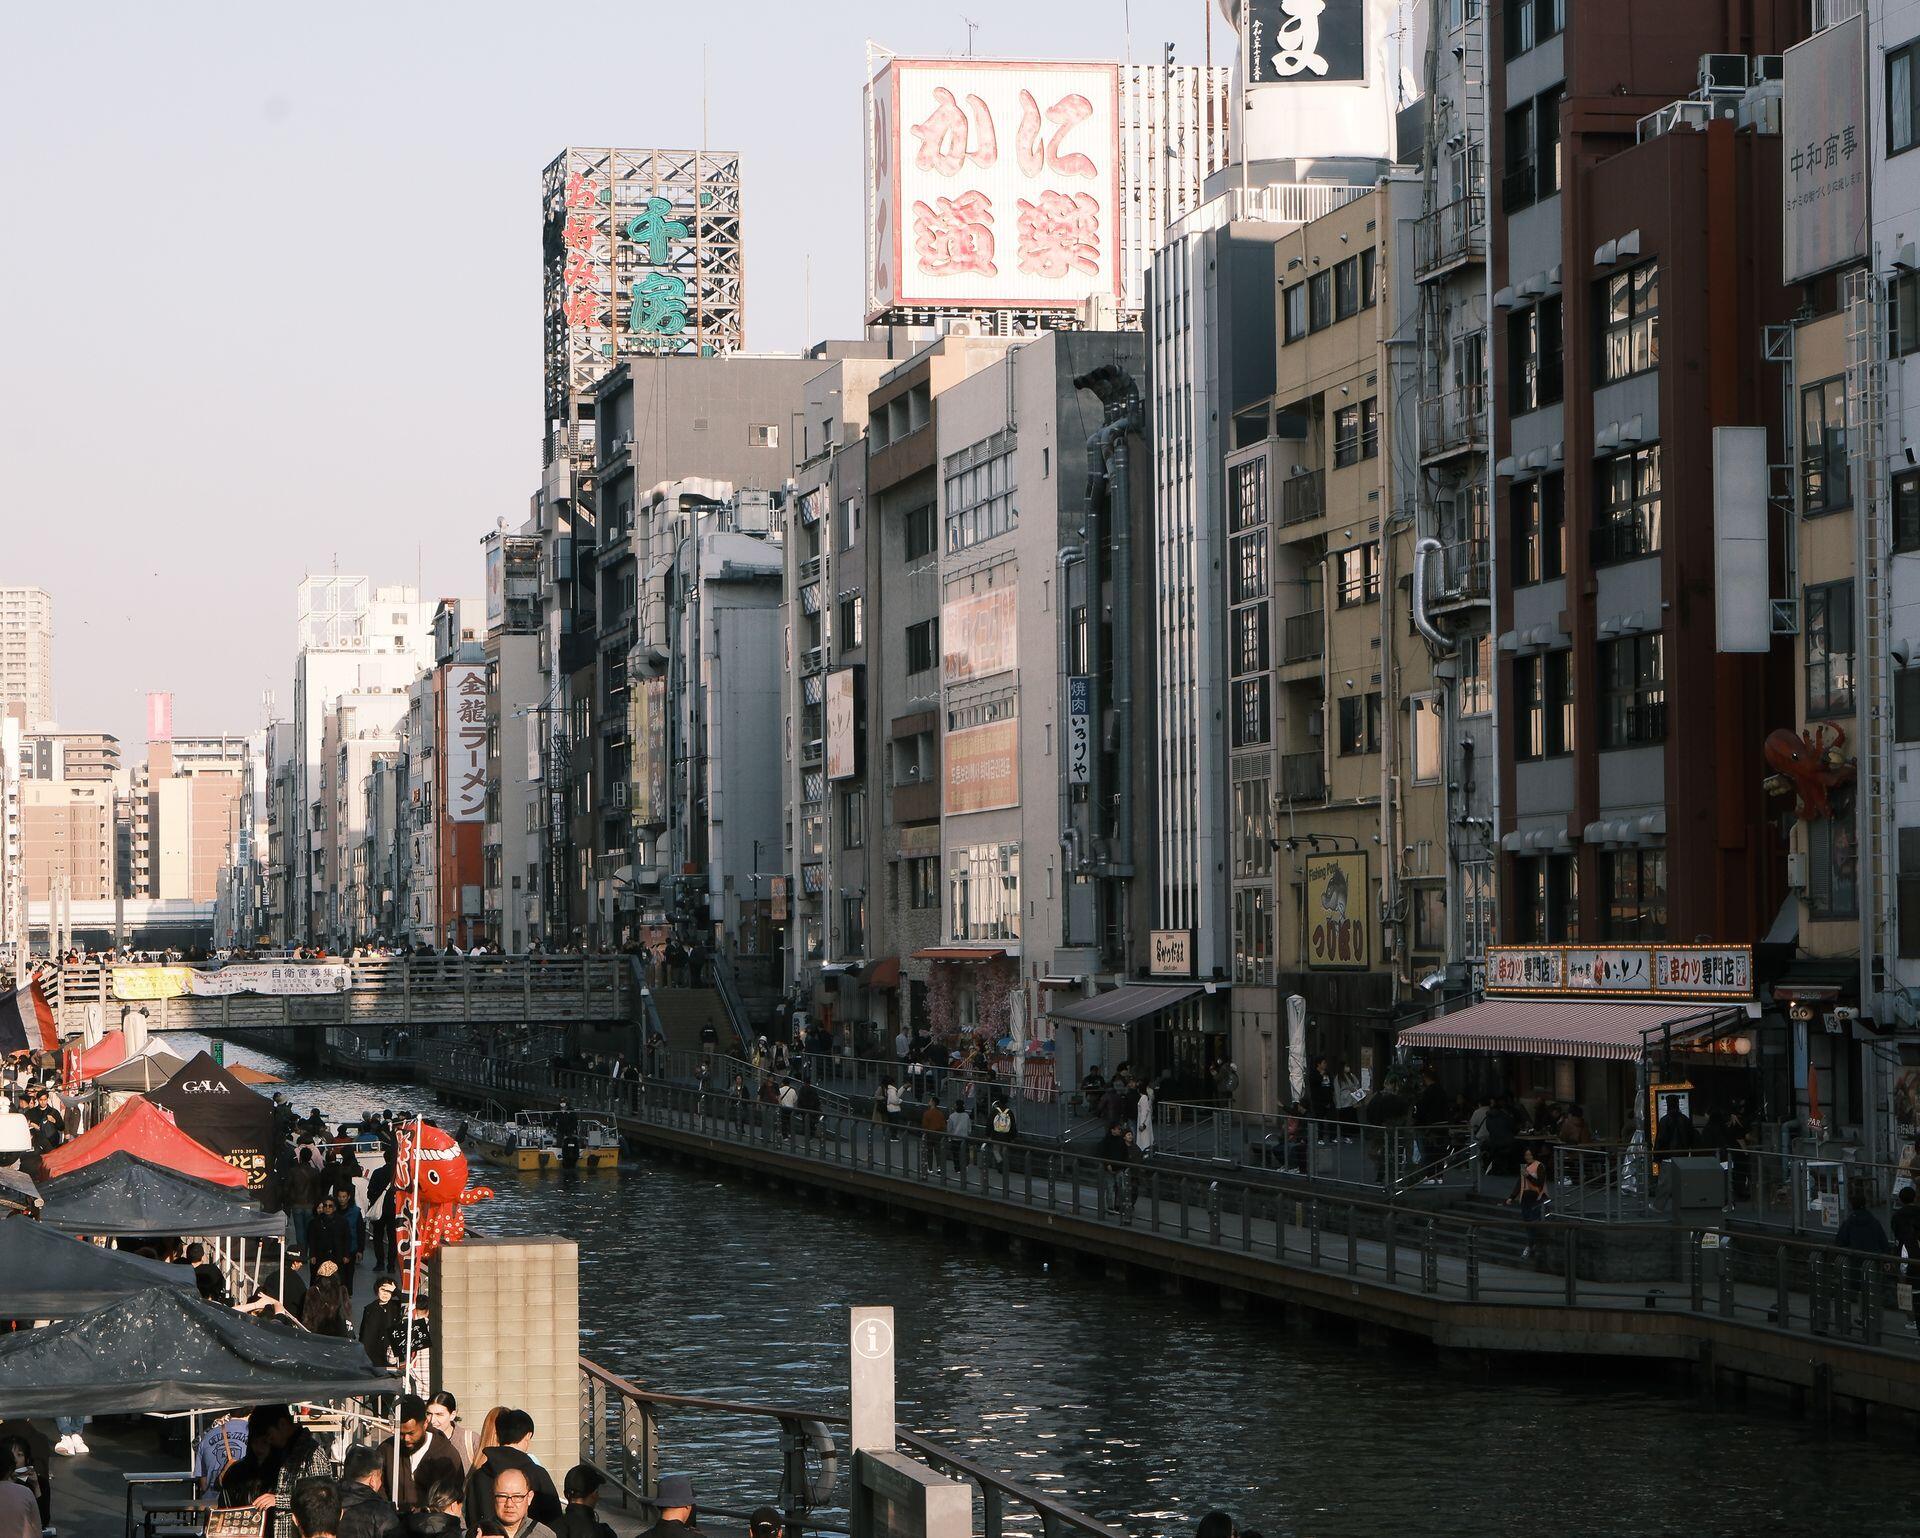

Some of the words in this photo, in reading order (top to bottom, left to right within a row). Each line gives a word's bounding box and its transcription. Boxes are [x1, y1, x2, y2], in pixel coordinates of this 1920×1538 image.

[910, 86, 1098, 179] かに
[1790, 124, 1858, 182] 中和商事
[562, 171, 600, 327] お好み焼
[627, 197, 689, 335] 千房
[1070, 681, 1087, 713] 焼肉
[456, 671, 487, 816] 金龍ラーメン
[1071, 717, 1088, 781] いろりや
[1309, 863, 1327, 883] Fishing
[271, 967, 347, 979] 自衛官募集中
[1498, 956, 1550, 982] 串カツ専門店
[1670, 956, 1735, 985] 串カツ専門店
[182, 1080, 229, 1092] GALA
